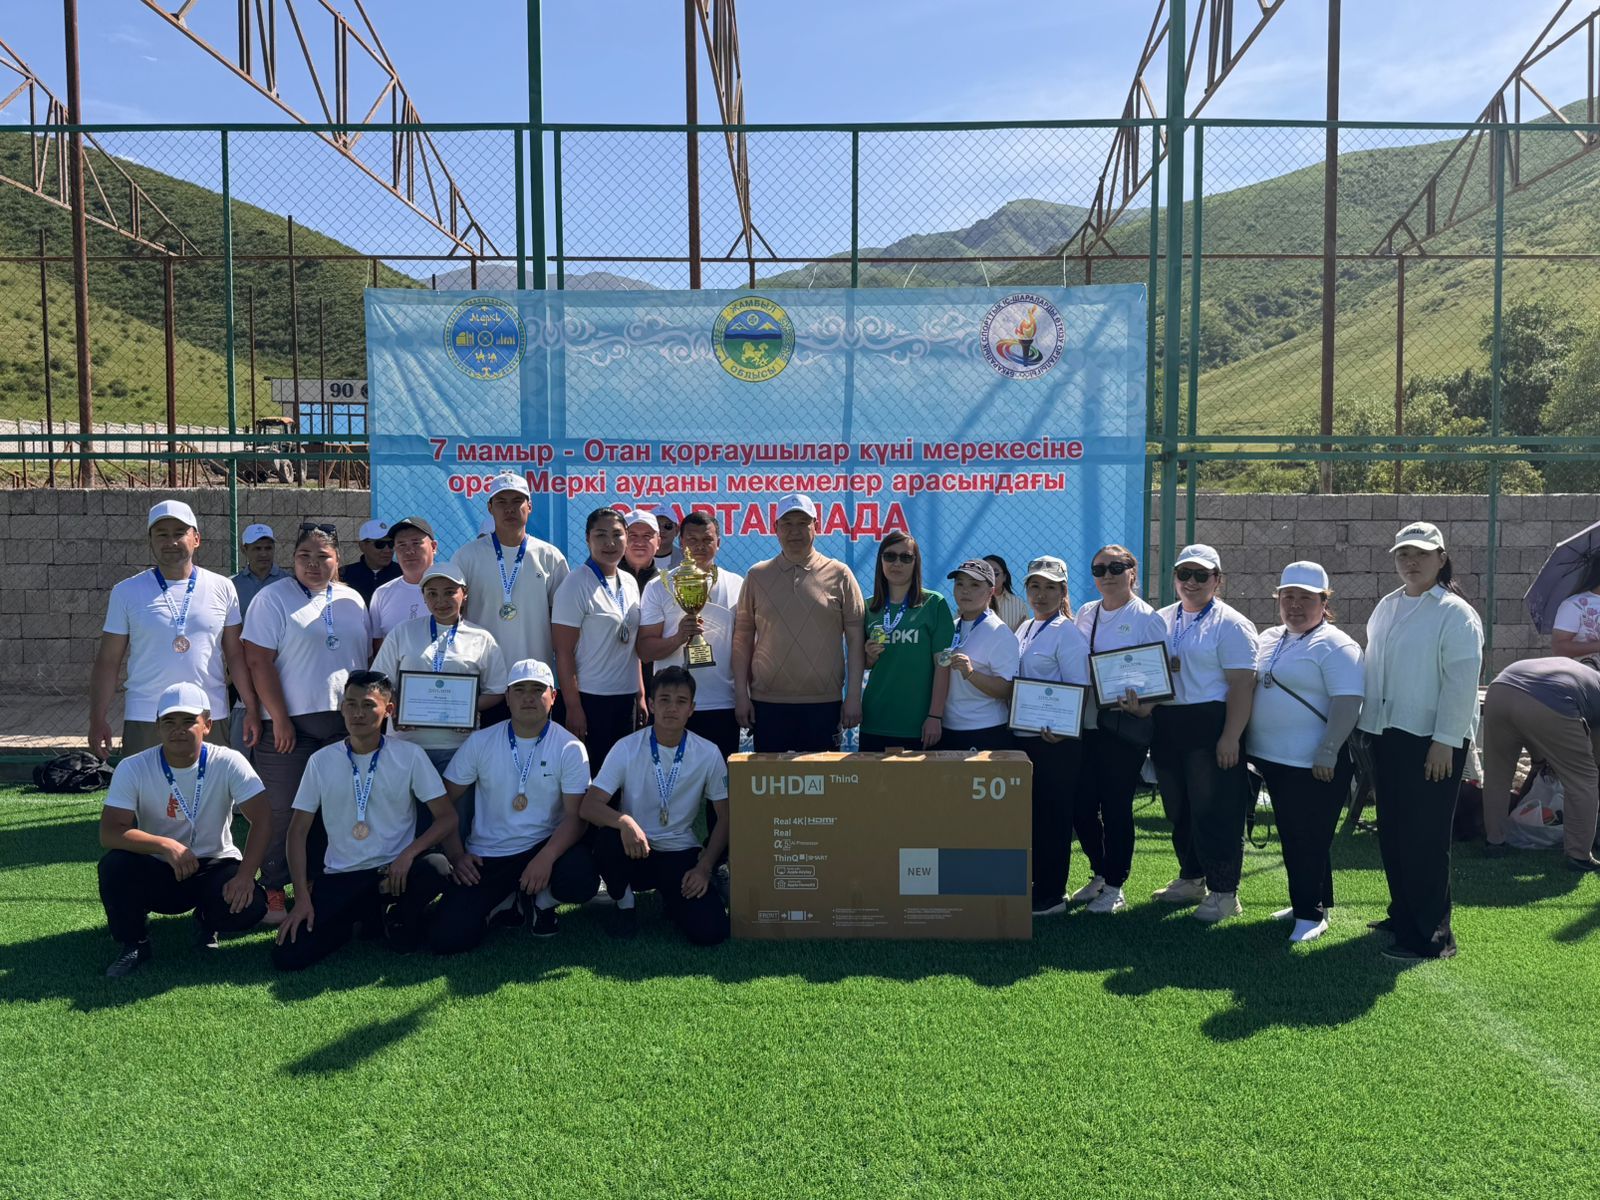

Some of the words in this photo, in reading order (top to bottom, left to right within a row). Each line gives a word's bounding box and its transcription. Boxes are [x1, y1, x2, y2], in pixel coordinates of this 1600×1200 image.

[729, 299, 777, 314] ЖАМБЫЛ
[730, 365, 777, 379] ОБЛЫСЫ
[330, 383, 354, 398] 90
[429, 438, 447, 461] 7
[457, 443, 554, 467] мамыр
[584, 439, 651, 462] Отан
[660, 439, 849, 468] қорғаушылар
[859, 438, 913, 466] күні
[922, 436, 1083, 464] мерекесіне
[525, 471, 606, 498] Меркі
[615, 474, 717, 499] ауданы
[727, 472, 882, 497] мекемелер
[891, 470, 1065, 496] арасындағы
[751, 775, 804, 795] UHD
[830, 774, 859, 784] ThinQ
[773, 817, 791, 825] Real
[792, 817, 804, 825] 4K
[773, 829, 792, 837] Real
[773, 854, 799, 862] ThinQ
[907, 867, 932, 876] NEW
[759, 911, 779, 919] FRONT
